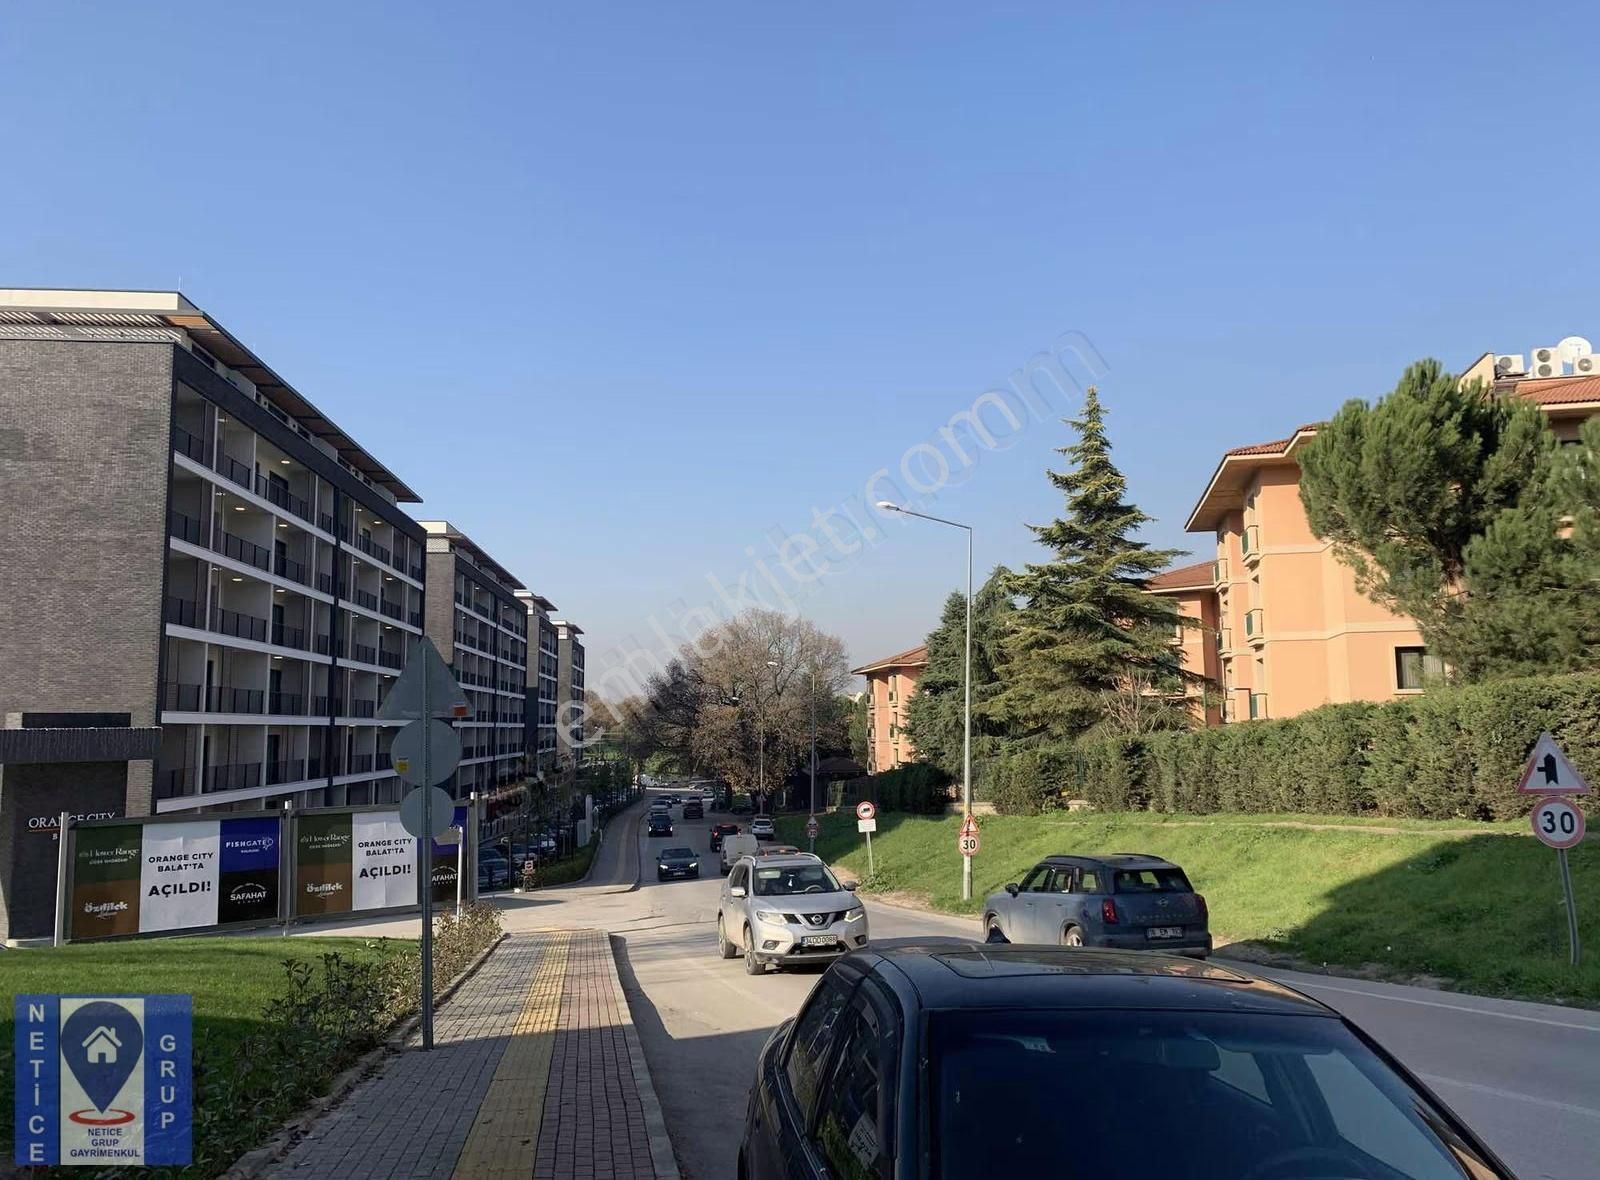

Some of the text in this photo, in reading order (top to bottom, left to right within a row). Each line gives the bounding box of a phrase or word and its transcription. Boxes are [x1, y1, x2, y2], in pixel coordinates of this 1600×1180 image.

[1542, 811, 1575, 834] 30
[225, 839, 267, 848] FISHGATE
[358, 838, 413, 848] ORANGE CITY
[963, 839, 976, 850] 30
[148, 852, 214, 863] ORANGE CITY
[366, 848, 405, 856] BALAT'TA
[157, 862, 204, 872] BALAT'TA
[359, 864, 411, 879] AÇILDI!
[431, 873, 458, 882] AFAHAT
[148, 881, 211, 898] AÇILDI!
[230, 890, 268, 901] SAFAHAT
